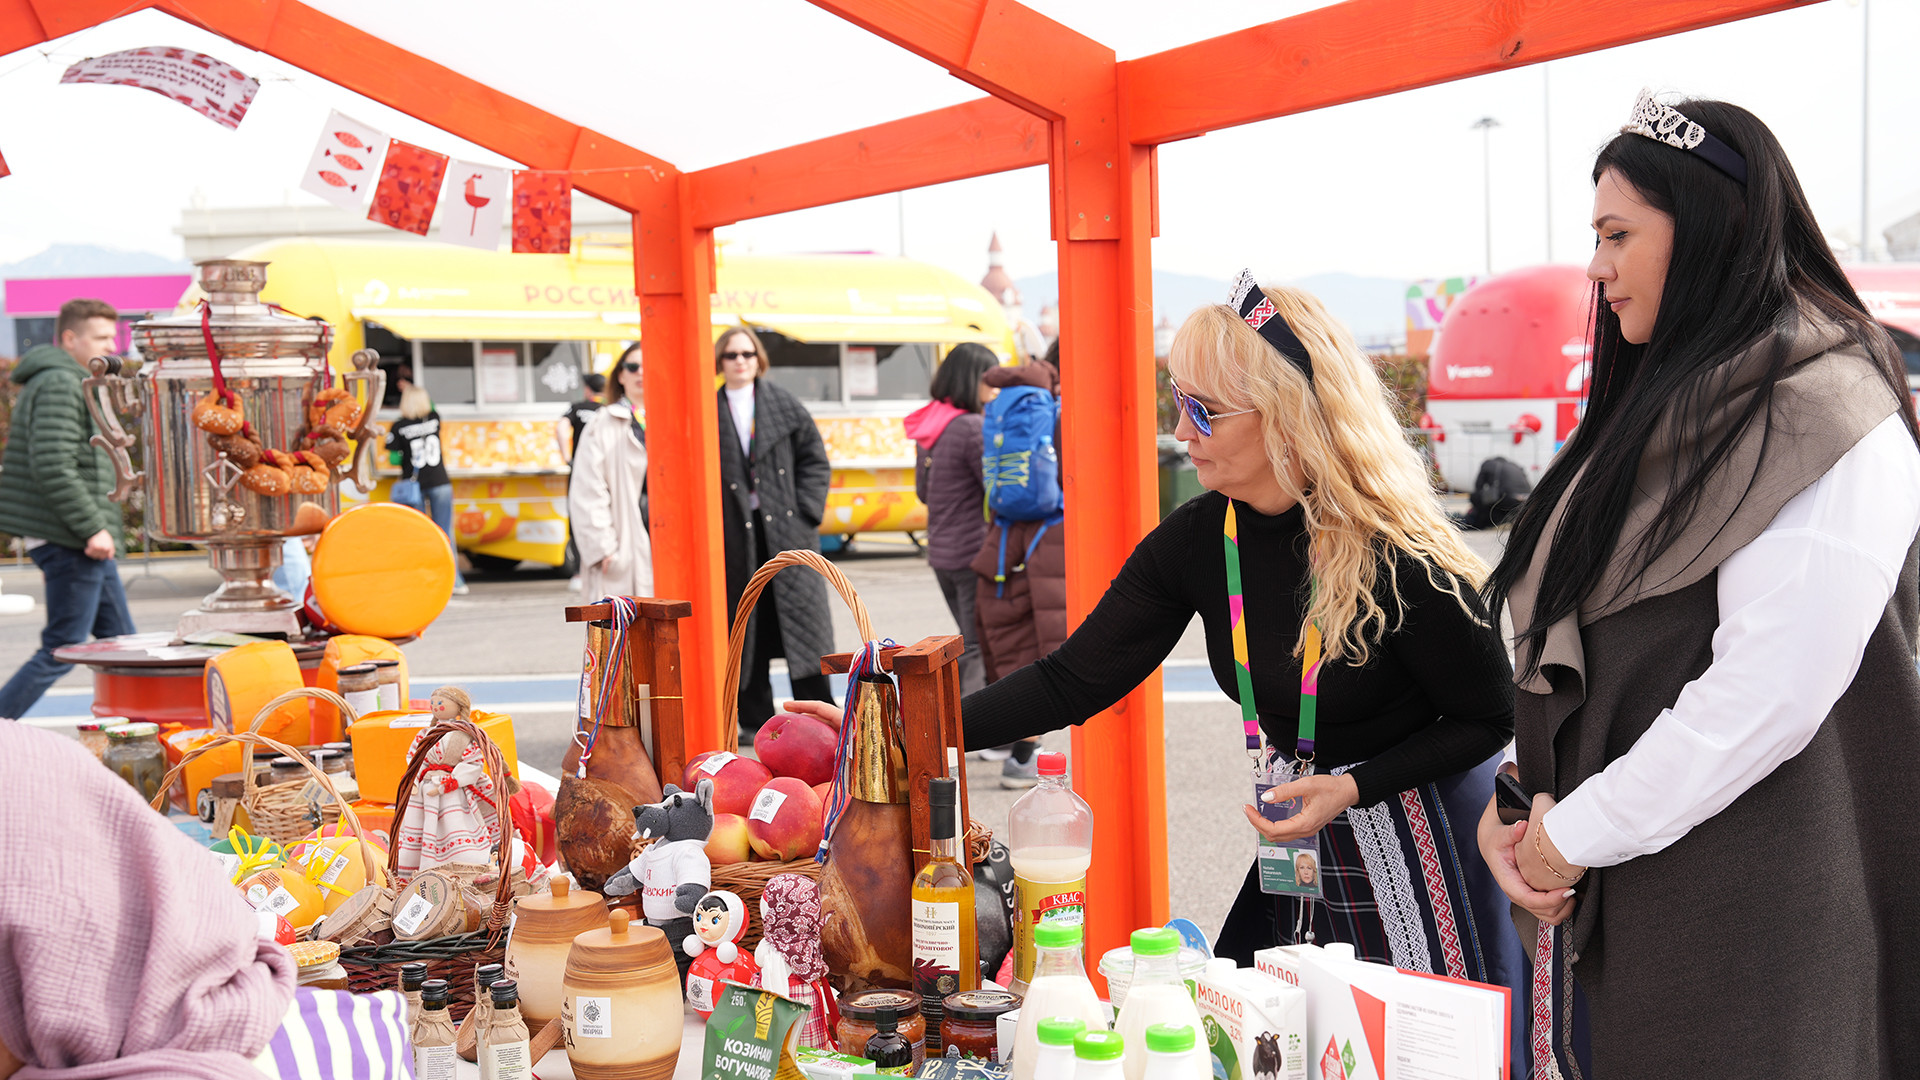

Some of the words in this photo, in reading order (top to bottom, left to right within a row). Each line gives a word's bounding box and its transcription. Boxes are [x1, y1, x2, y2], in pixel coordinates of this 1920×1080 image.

[1052, 891, 1080, 905] КВАС
[1197, 982, 1243, 1018] МОЛОКО
[919, 1059, 943, 1079] 12
